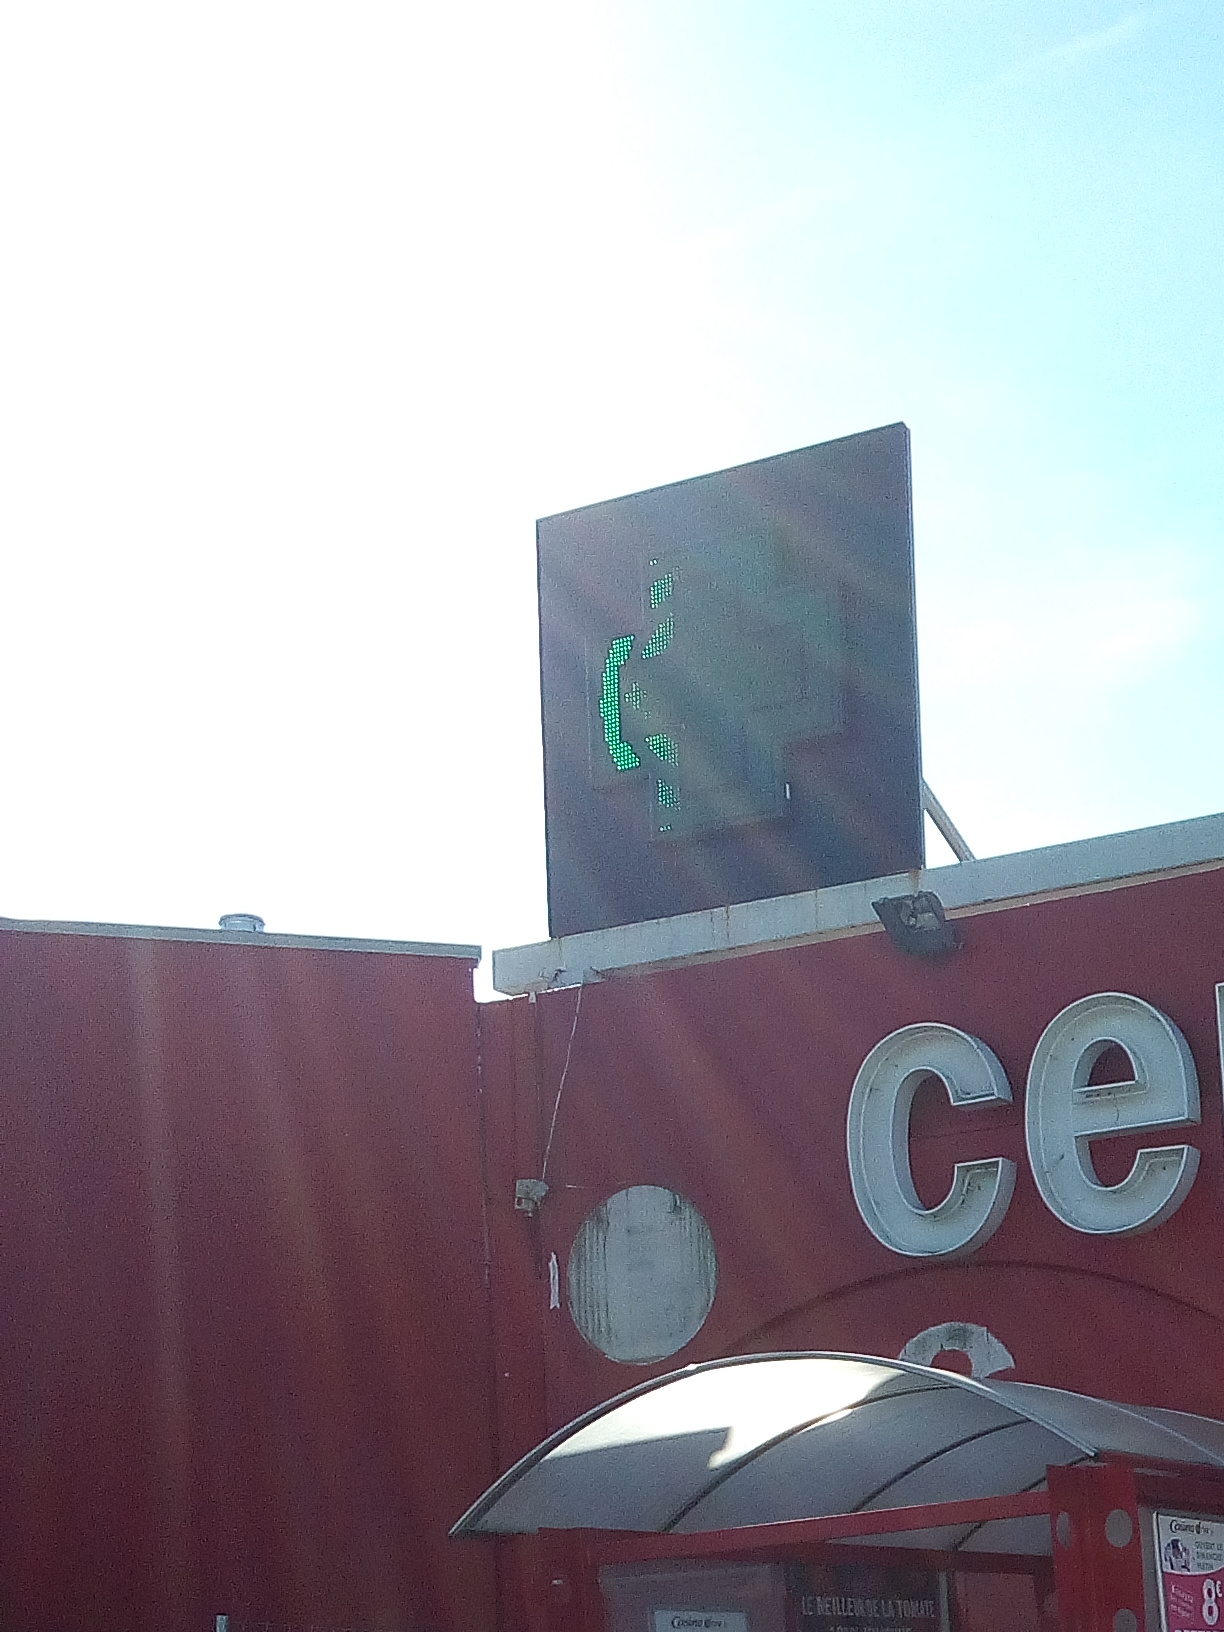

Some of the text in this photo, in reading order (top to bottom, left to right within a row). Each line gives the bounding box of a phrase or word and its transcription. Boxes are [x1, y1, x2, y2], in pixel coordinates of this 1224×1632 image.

[801, 1596, 814, 1616] LE
[881, 1599, 895, 1618] LA
[896, 1599, 935, 1619] TOMATE
